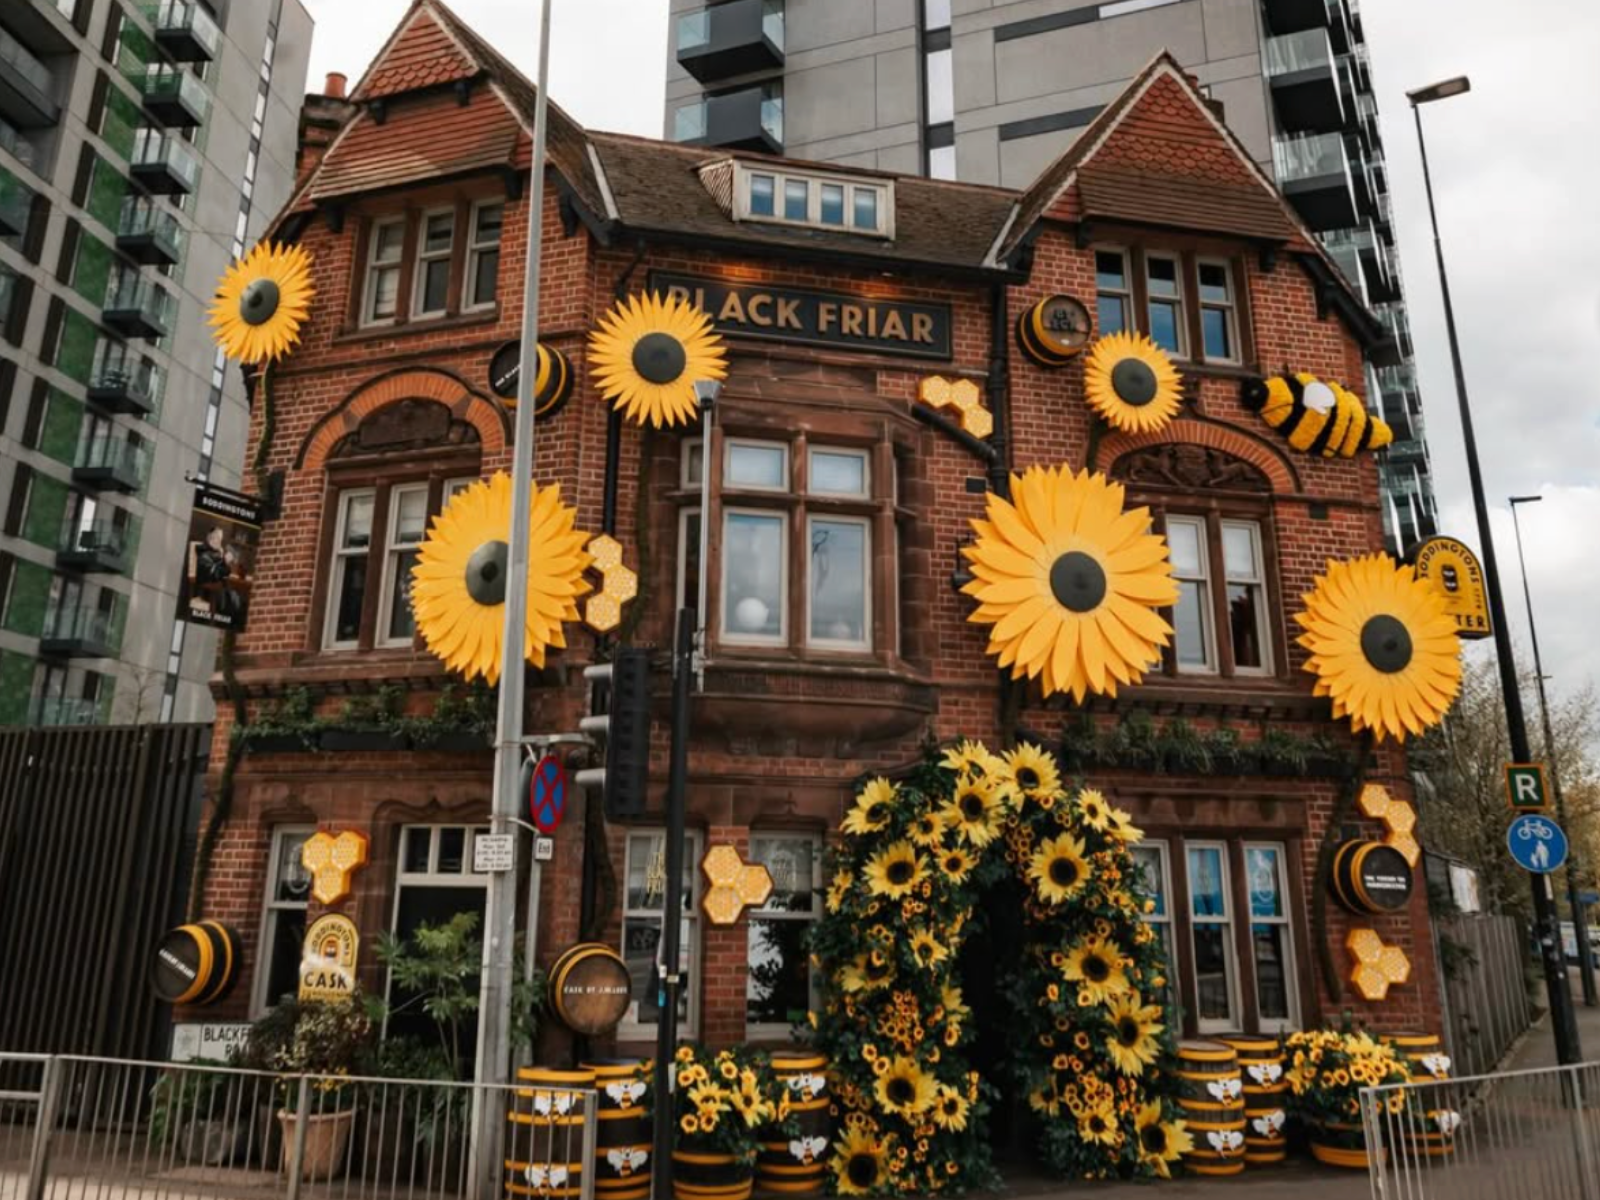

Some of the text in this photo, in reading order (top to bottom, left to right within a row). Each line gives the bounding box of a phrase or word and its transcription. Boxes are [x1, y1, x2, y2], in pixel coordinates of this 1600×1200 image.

[818, 302, 934, 343] FRIAR
[1515, 773, 1539, 800] R
[304, 971, 348, 989] CASK
